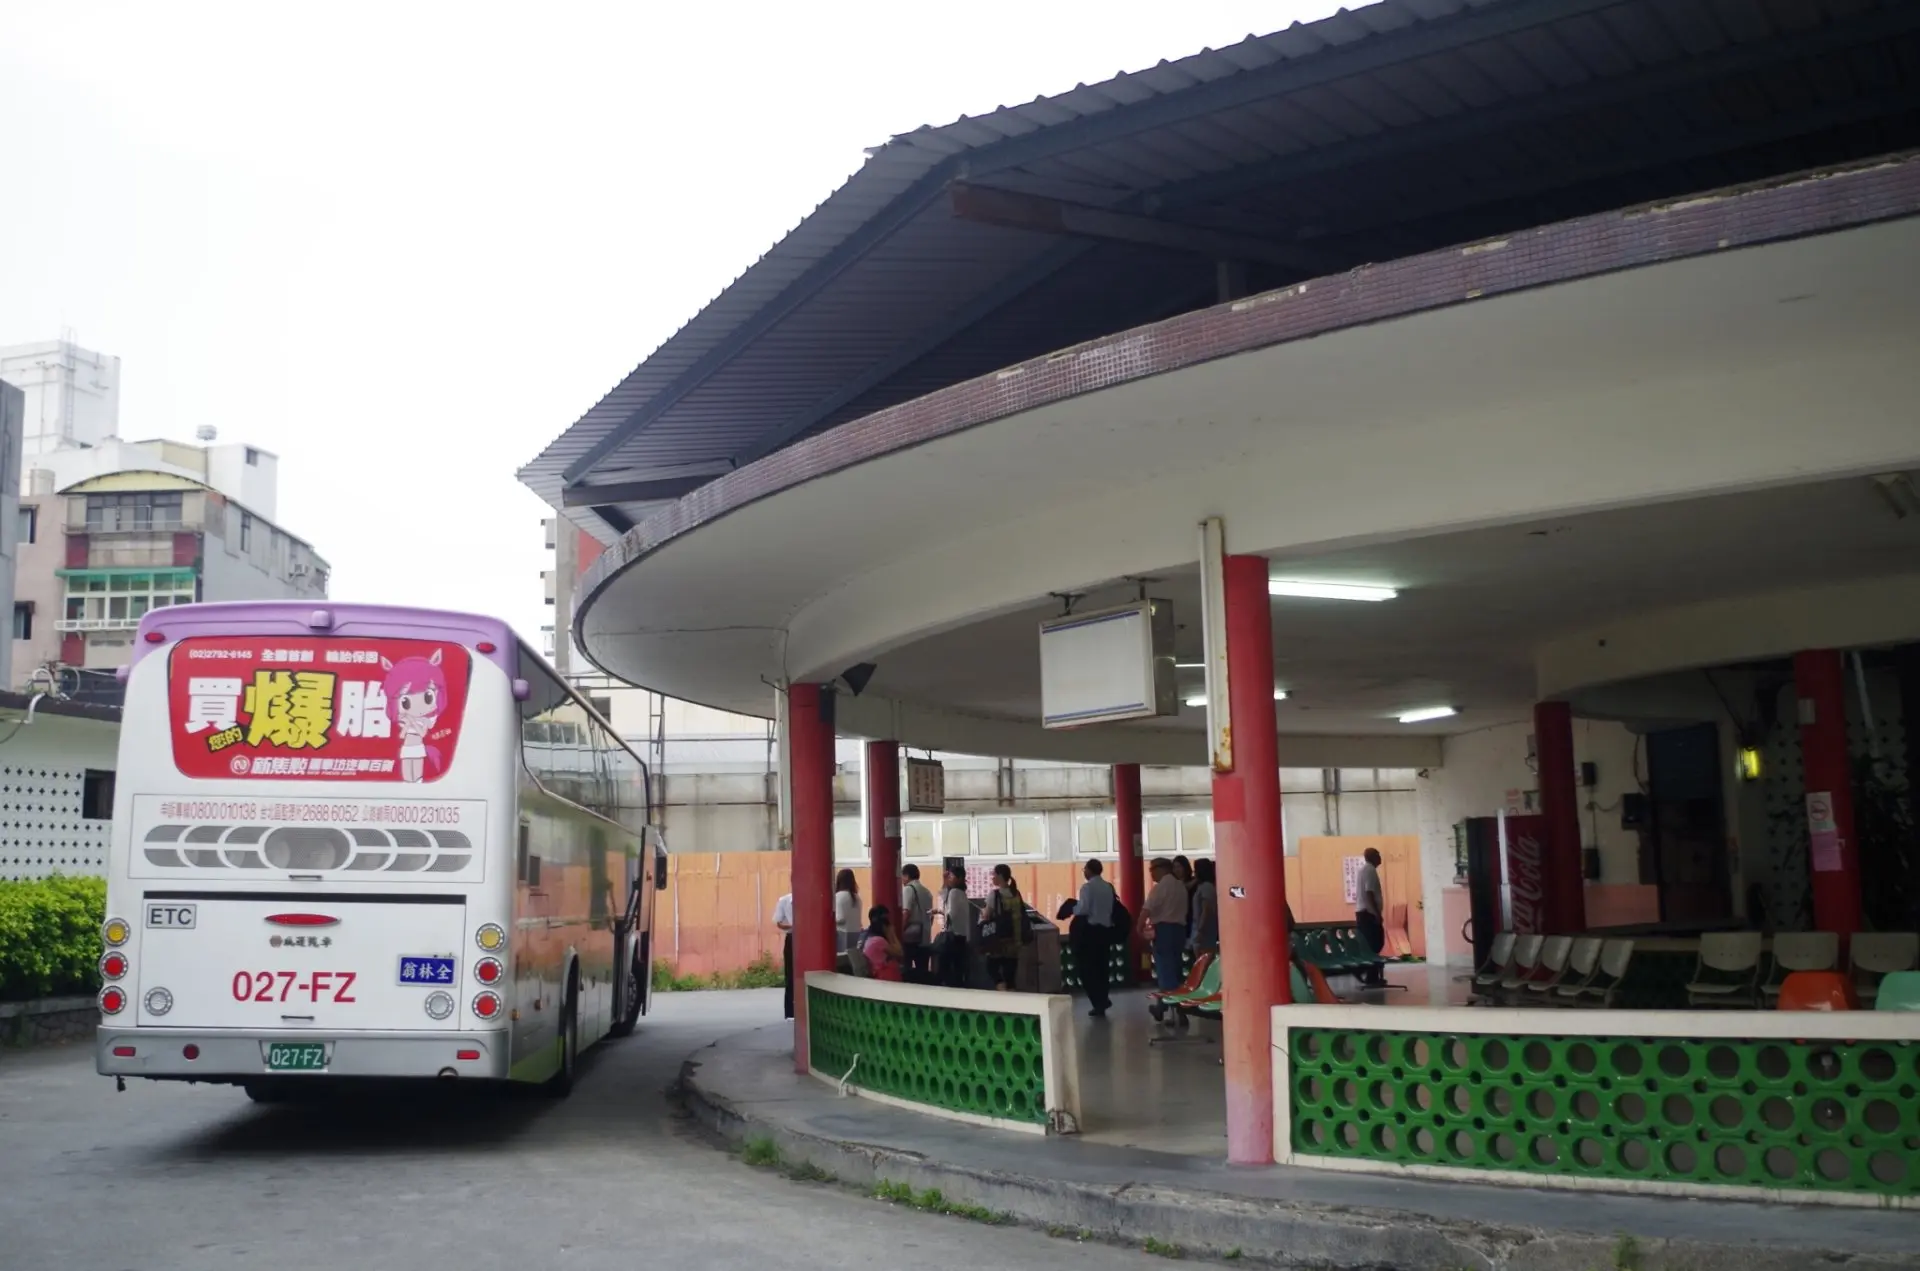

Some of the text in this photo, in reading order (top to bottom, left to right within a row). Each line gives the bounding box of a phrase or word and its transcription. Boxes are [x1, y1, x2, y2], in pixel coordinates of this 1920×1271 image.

[208, 727, 243, 751] 您的
[151, 908, 192, 925] ETC
[232, 971, 357, 1003] 027-FZ
[271, 1048, 323, 1066] 027-FZ
